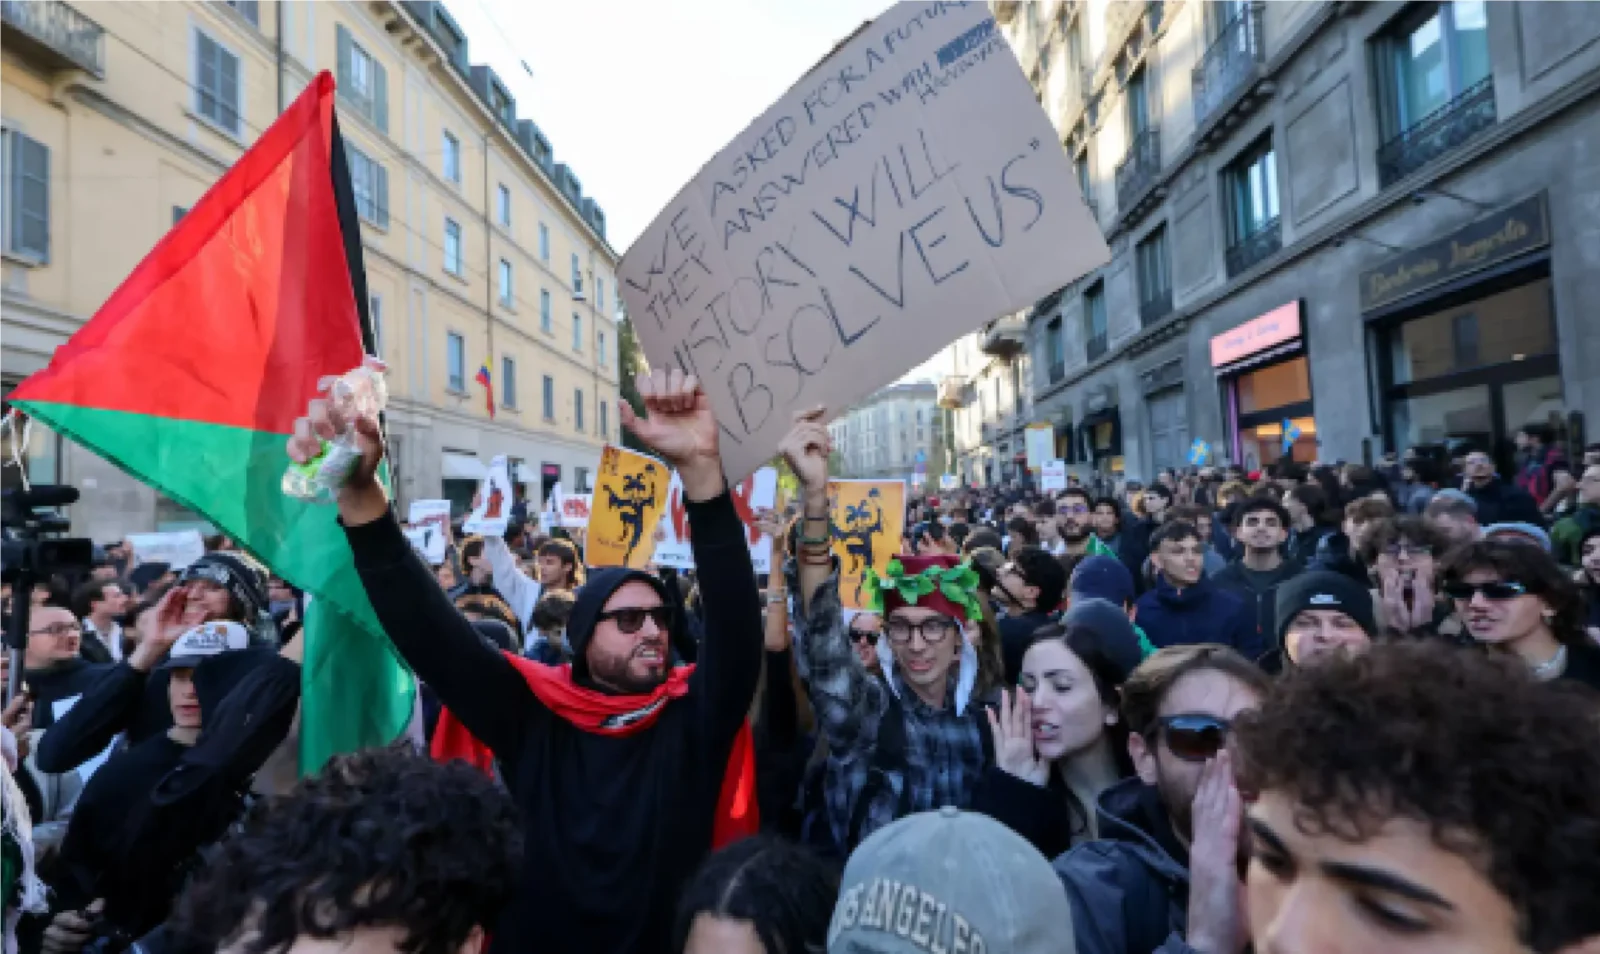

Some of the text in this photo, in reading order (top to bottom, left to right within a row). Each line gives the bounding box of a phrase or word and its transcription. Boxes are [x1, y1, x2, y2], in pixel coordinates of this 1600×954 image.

[626, 204, 698, 293] WE
[711, 115, 797, 217] ASKED
[802, 63, 866, 125] FOR
[866, 47, 884, 73] A
[883, 1, 969, 54] FUTUR
[646, 60, 932, 330] THEY ANSWERED WITH
[810, 127, 960, 248] WILL
